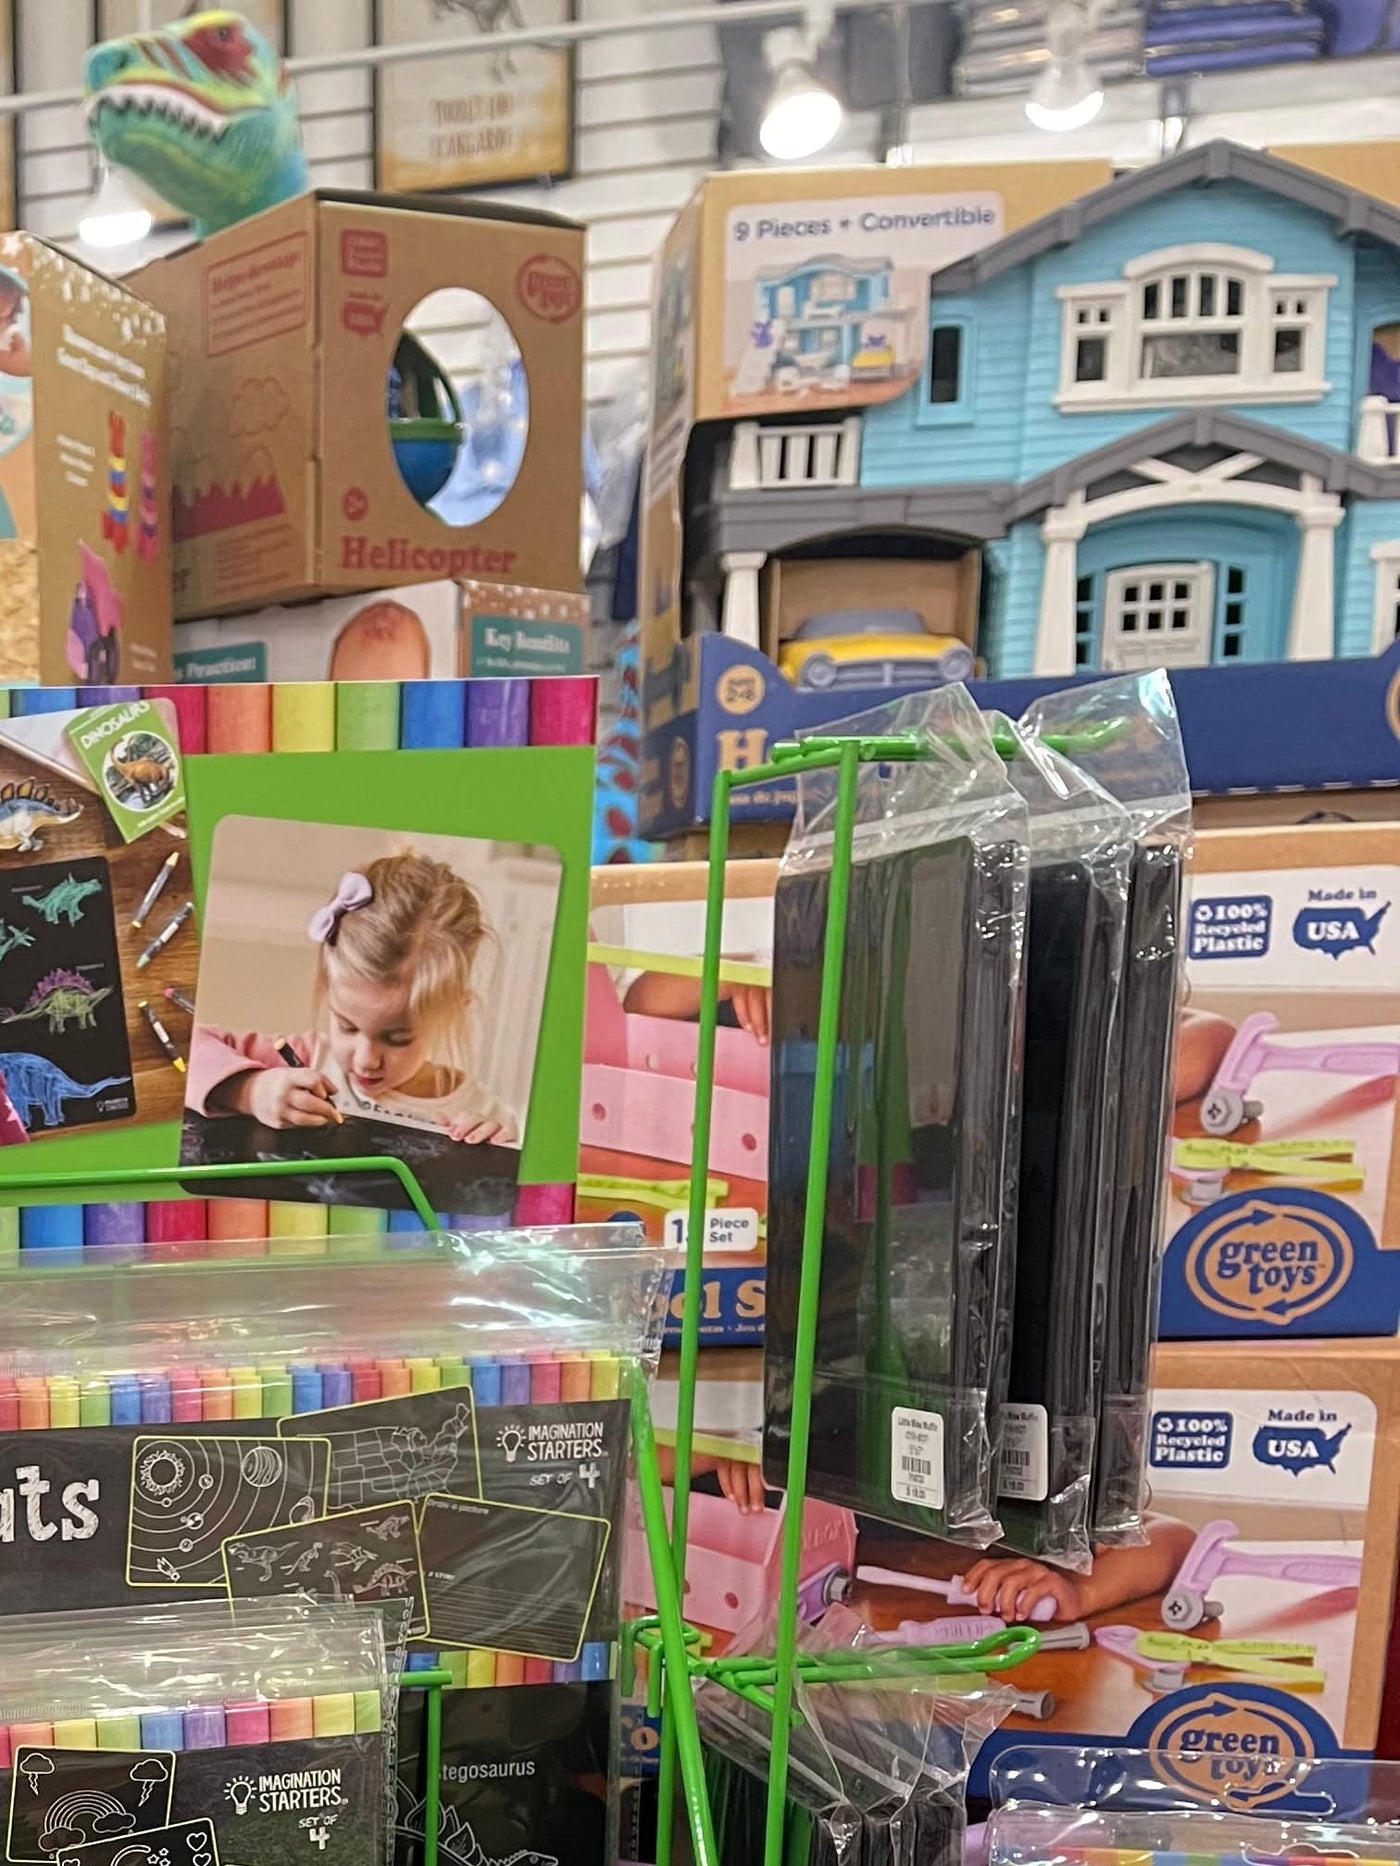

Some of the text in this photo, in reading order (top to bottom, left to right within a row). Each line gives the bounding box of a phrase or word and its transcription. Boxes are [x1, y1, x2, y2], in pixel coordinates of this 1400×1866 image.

[734, 205, 996, 241] 9 Pieces Convertible
[342, 535, 518, 577] Helicopter
[1308, 888, 1355, 902] Made
[1215, 904, 1268, 920] 100%
[1195, 920, 1266, 938] Recycled
[1307, 922, 1360, 941] USA
[1194, 936, 1264, 954] Plastic
[710, 1218, 749, 1229] Piece
[710, 1232, 733, 1242] Set
[1217, 1239, 1319, 1278] green
[1247, 1263, 1317, 1295] toys
[1268, 1410, 1315, 1422] Made
[528, 1422, 603, 1440] IMAGINATION
[1176, 1419, 1228, 1433] 100%
[1157, 1435, 1225, 1449] Recycled
[1268, 1440, 1319, 1458] USA
[1155, 1447, 1224, 1462] Plastic
[530, 1464, 600, 1489] SET 4
[1179, 1727, 1281, 1767] green
[435, 1759, 536, 1782] tegosaurus
[259, 1769, 341, 1792] IMAGINATION
